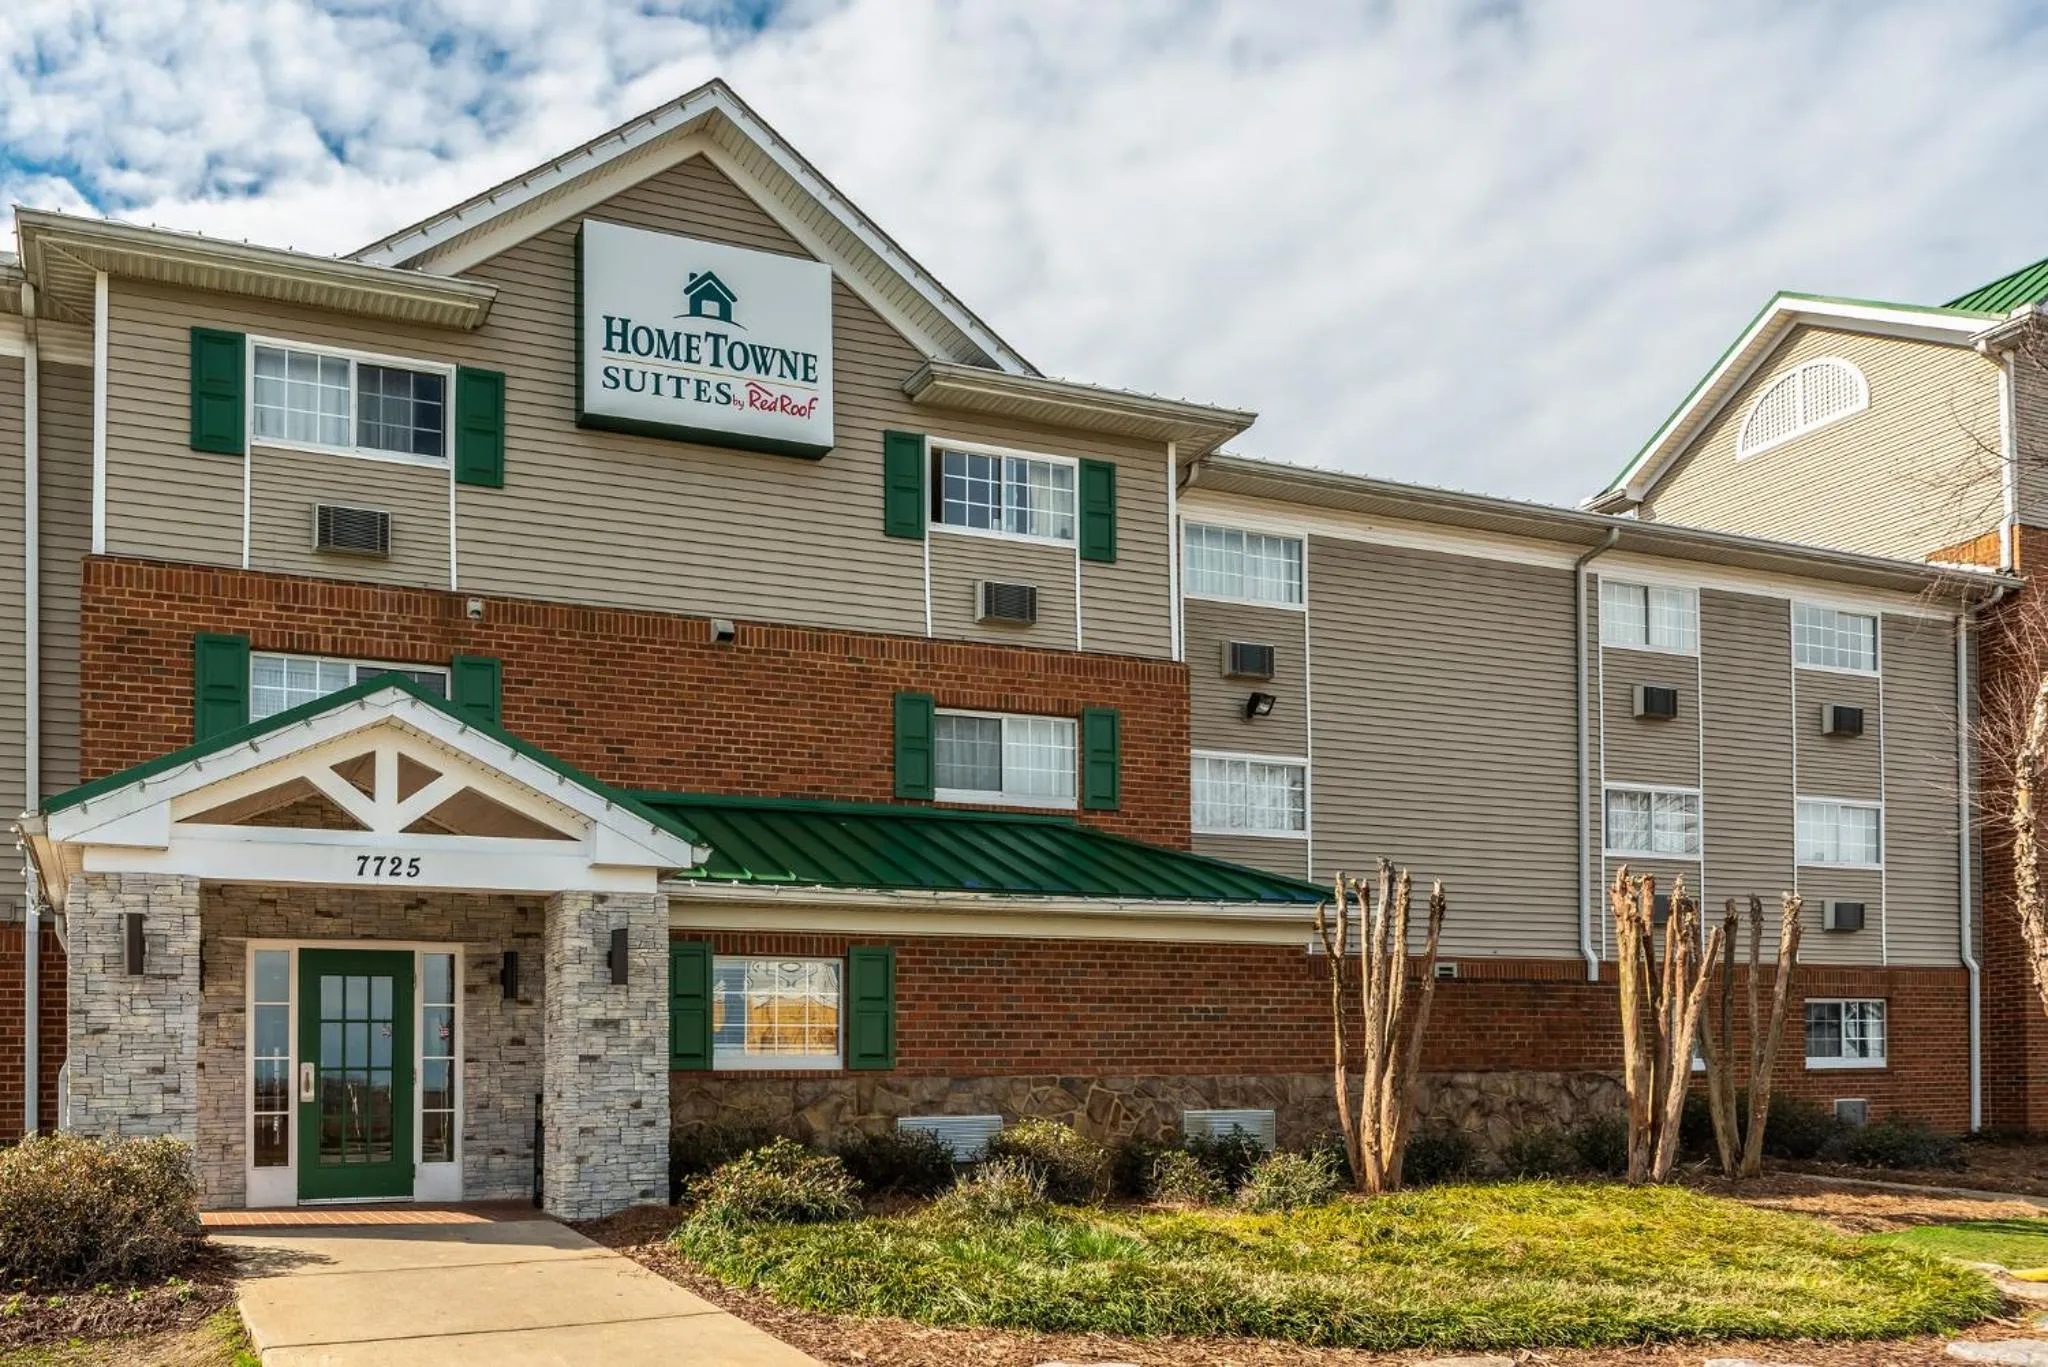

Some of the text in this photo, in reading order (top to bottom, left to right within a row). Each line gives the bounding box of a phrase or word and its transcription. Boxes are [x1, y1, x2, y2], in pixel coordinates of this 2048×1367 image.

[601, 366, 732, 405] SUITES
[732, 394, 745, 411] by
[357, 855, 421, 878] 7725
